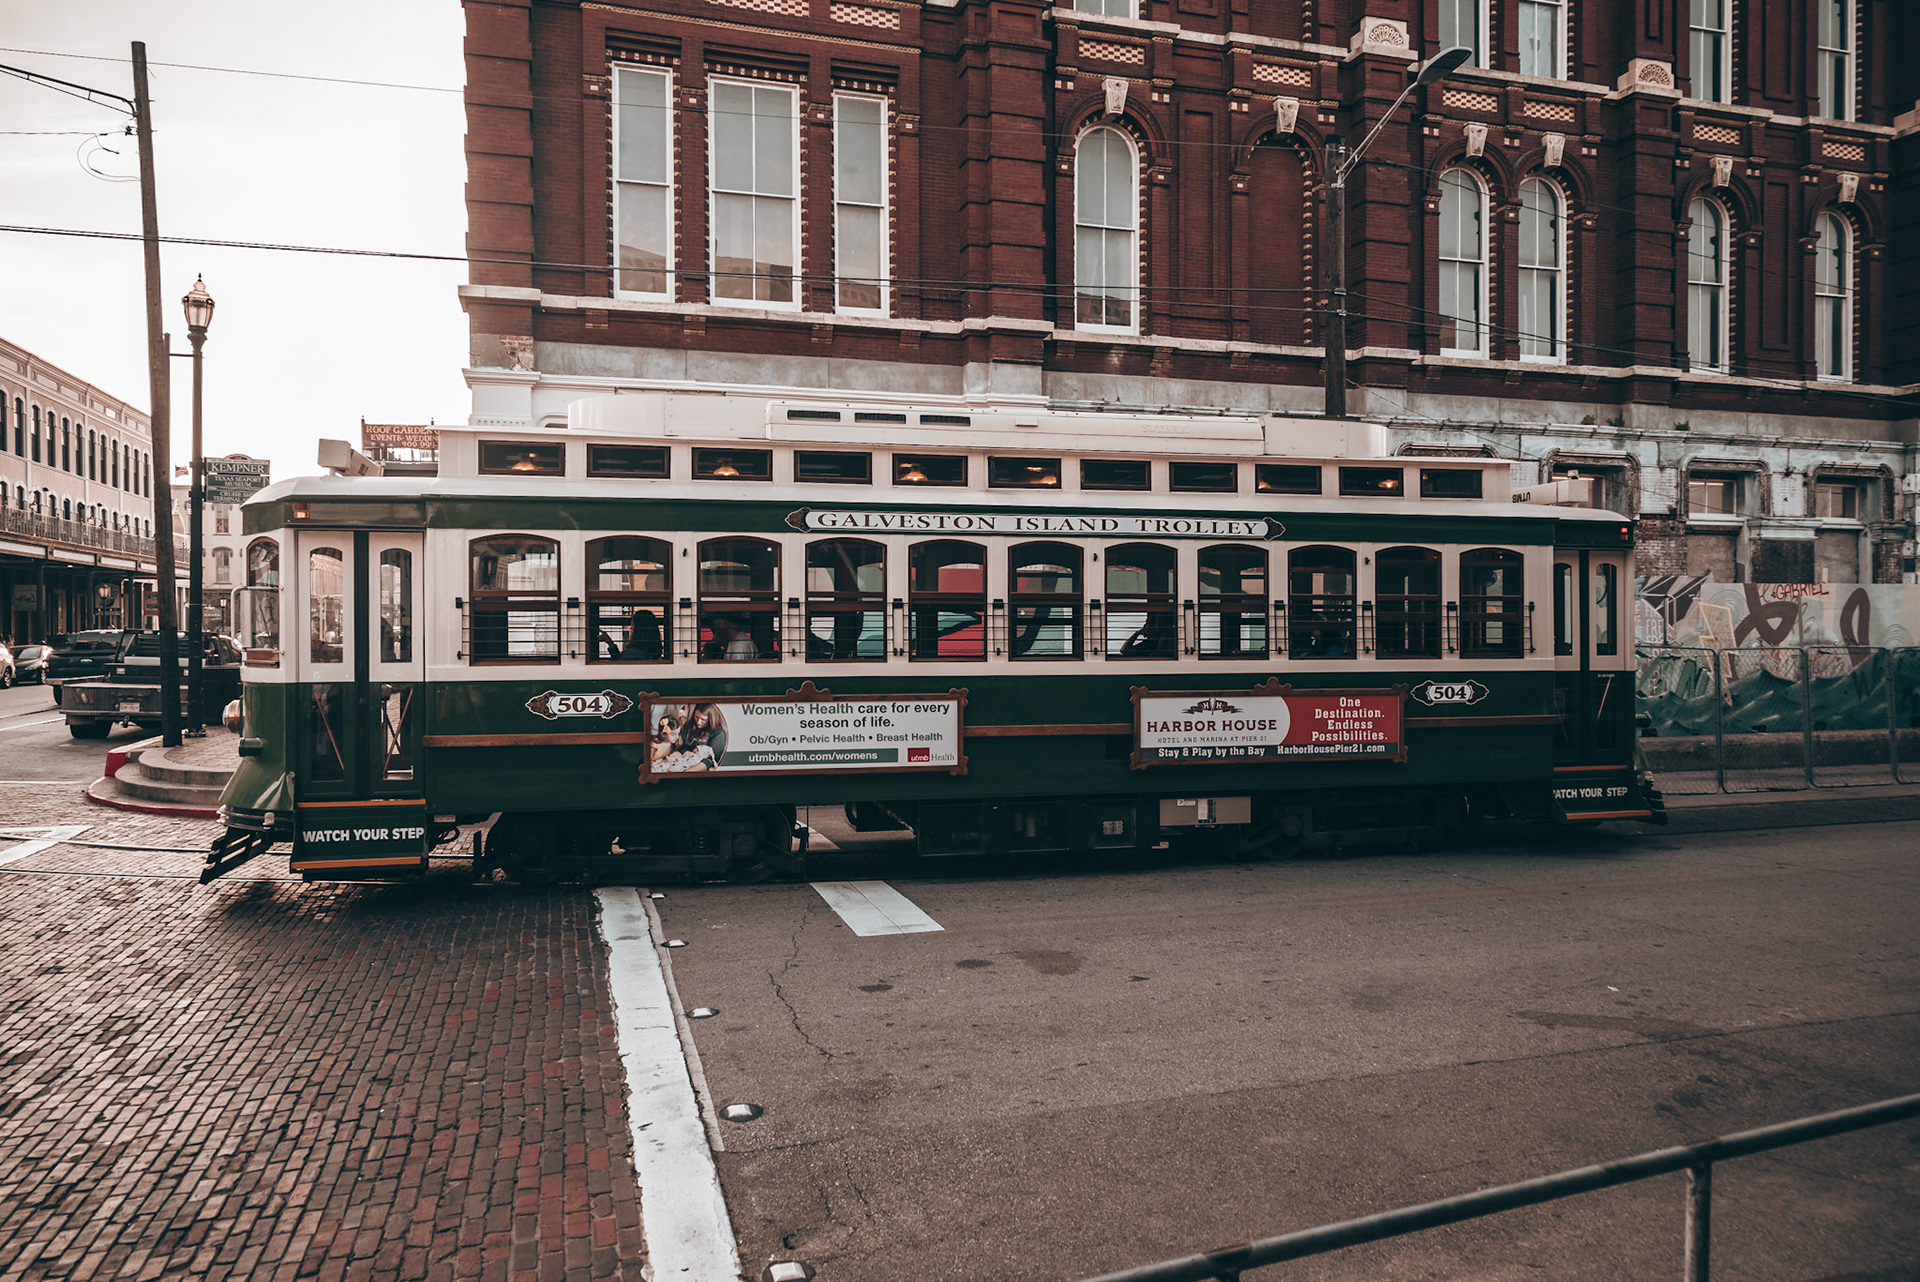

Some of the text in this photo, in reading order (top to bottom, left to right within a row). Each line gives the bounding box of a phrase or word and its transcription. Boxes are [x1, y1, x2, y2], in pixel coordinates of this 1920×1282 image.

[366, 425, 392, 433] ROOF
[406, 434, 439, 442] WEDDIN
[211, 462, 265, 473] KEMPNER
[817, 512, 1258, 535] GALVESTON ISLAND TROLLEY
[1775, 583, 1830, 600] GABRIEL
[1433, 685, 1467, 700] 504
[557, 697, 603, 713] 504
[1339, 696, 1361, 707] One
[741, 702, 950, 716] Women's Health care for every
[1314, 708, 1385, 719] Destination.
[799, 715, 895, 729] season of life.
[1146, 719, 1278, 733] HARBOR HOUSE
[1327, 719, 1374, 730] Endless
[749, 732, 944, 746] Ob/Gyn Pelvic Health Breast Health
[1157, 736, 1181, 744] HOTEL
[1311, 730, 1388, 742] Possibilities.
[1158, 745, 1266, 759] Stay & Play by the Bay
[1277, 743, 1386, 755] HarborHousePier21.com
[748, 752, 879, 763] utmbhealth.com/womens
[910, 753, 956, 762] utmb Health
[1552, 786, 1628, 799] ATCH YOUR STEP
[302, 827, 425, 842] WATCH YOUR STEP
